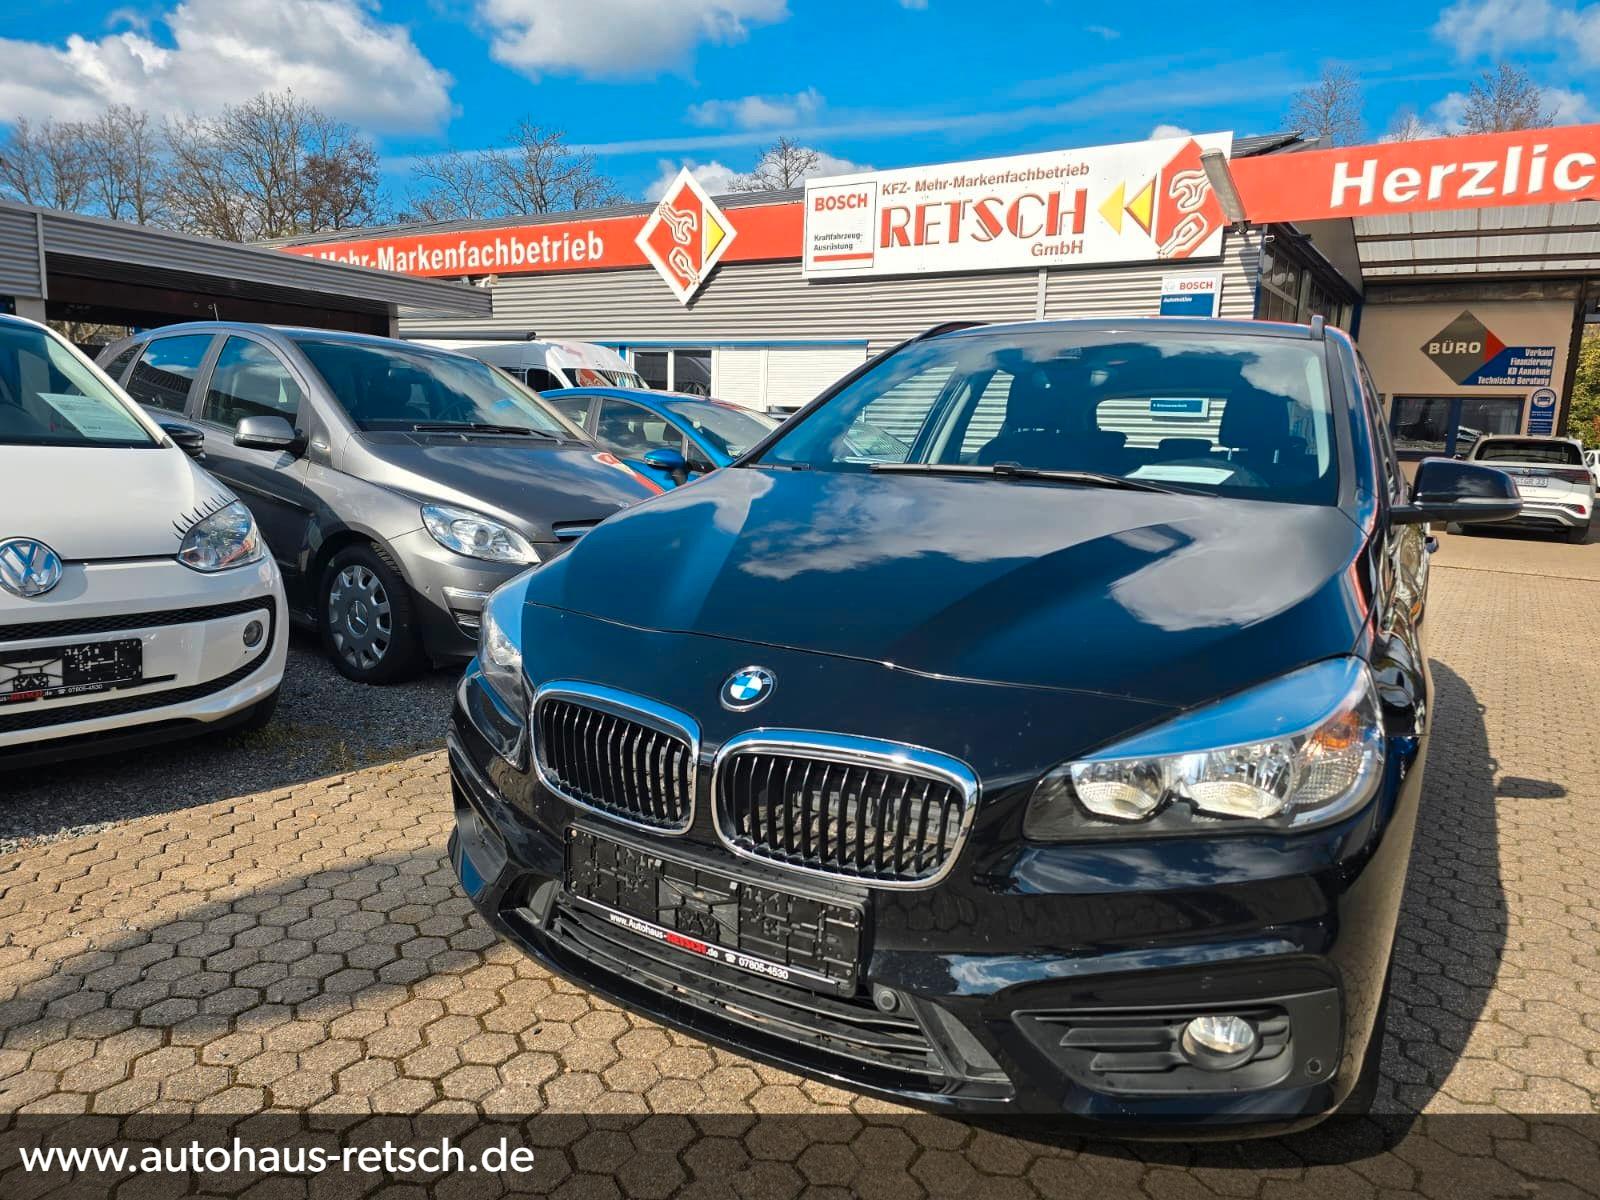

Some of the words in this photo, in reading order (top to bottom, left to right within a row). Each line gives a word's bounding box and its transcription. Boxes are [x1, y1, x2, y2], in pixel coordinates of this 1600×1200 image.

[881, 181, 911, 196] KFZ-
[915, 162, 1090, 193] Mehr-Markenfachbetrieb
[1330, 143, 1597, 208] Herzlic
[814, 192, 868, 212] BOSCH
[880, 188, 1088, 248] RETSCH
[814, 232, 863, 241] Kraftfahrzeug-
[813, 242, 854, 252] Ausrüstung
[1031, 240, 1084, 257] GmbH
[1179, 280, 1213, 291] BOSCH
[1428, 340, 1481, 355] BÜRO
[1525, 348, 1554, 357] Verkauf
[1510, 357, 1553, 366] Finanzierung
[1478, 376, 1517, 385] Technische
[738, 957, 789, 981] 07805-4530
